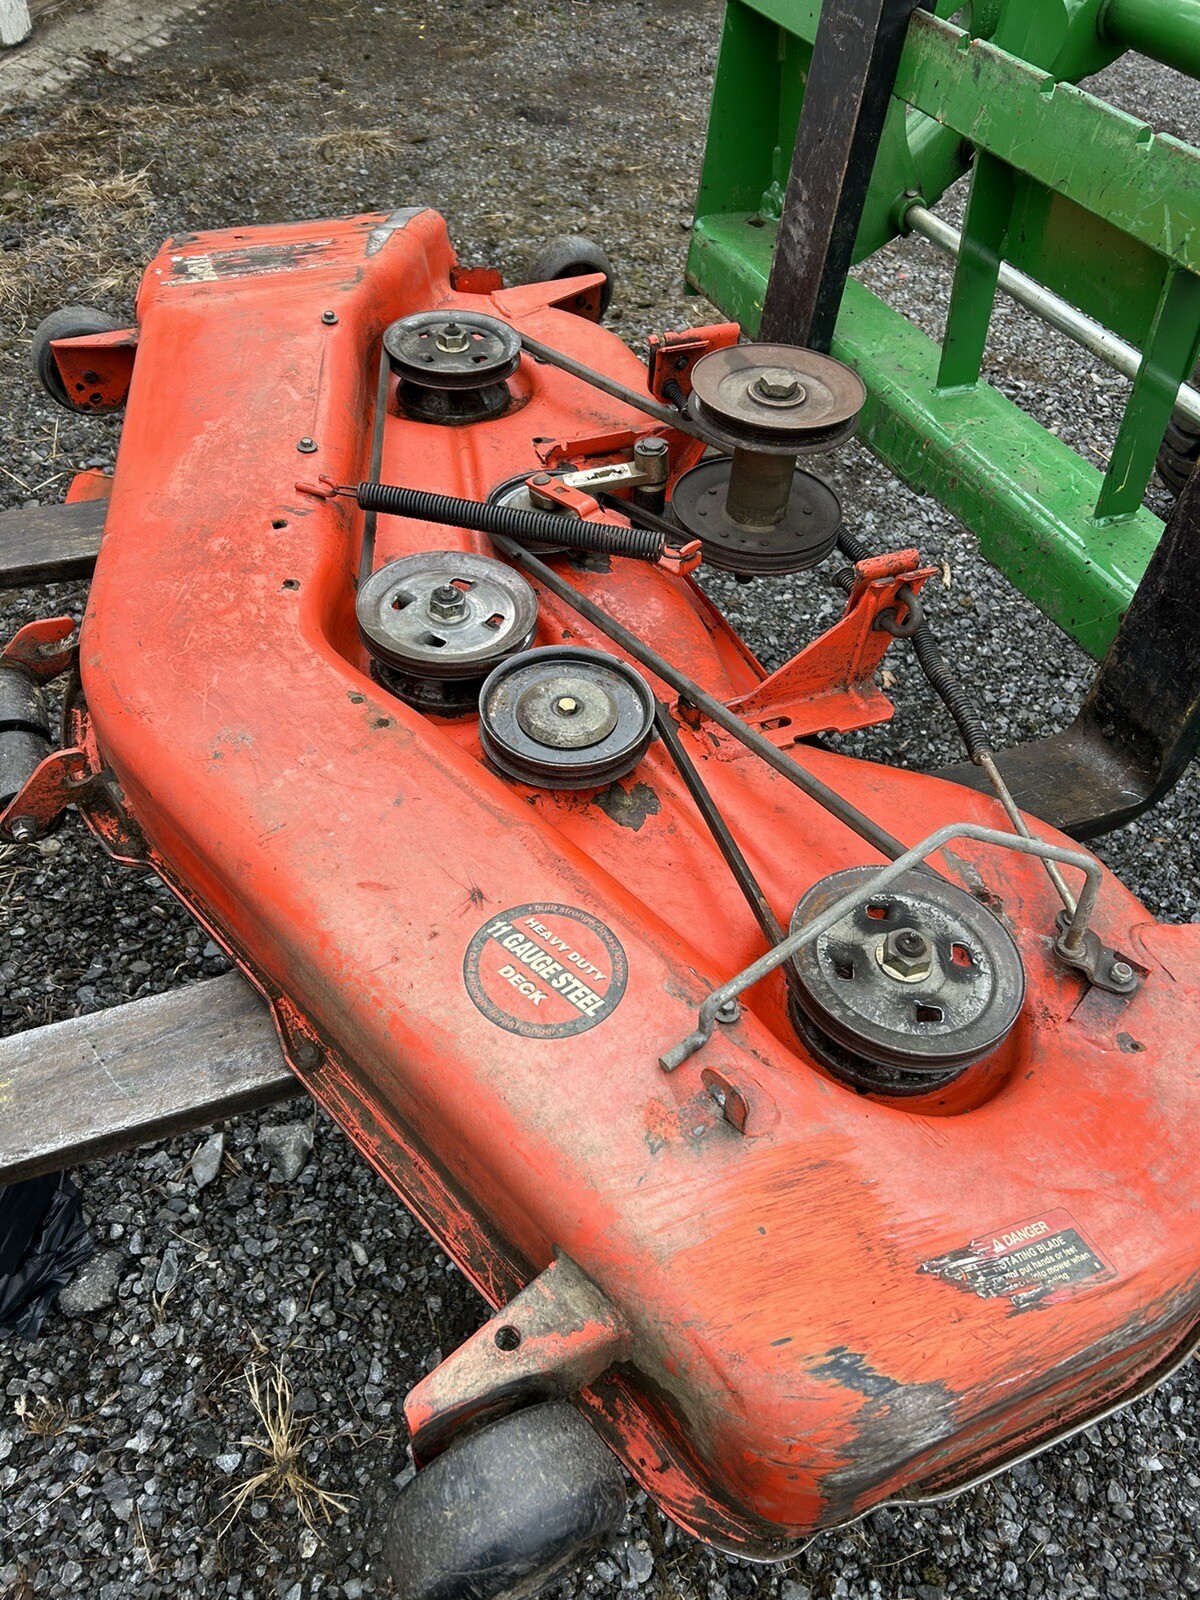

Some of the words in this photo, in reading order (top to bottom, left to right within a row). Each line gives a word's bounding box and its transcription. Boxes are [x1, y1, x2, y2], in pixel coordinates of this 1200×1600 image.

[524, 917, 571, 953] HEAVY
[567, 951, 607, 981] DUTY
[487, 920, 514, 939] 11
[502, 933, 564, 980] GAUGE
[551, 972, 606, 1017] STEEL
[497, 964, 549, 1006] DECK
[1001, 1220, 1050, 1247] DANGER
[1036, 1236, 1067, 1254] BLADE
[1018, 1264, 1033, 1277] put
[1030, 1255, 1056, 1270] hands
[1054, 1251, 1064, 1260] or
[1061, 1245, 1079, 1257] feet
[1046, 1260, 1072, 1275] mower
[1070, 1252, 1091, 1265] when
